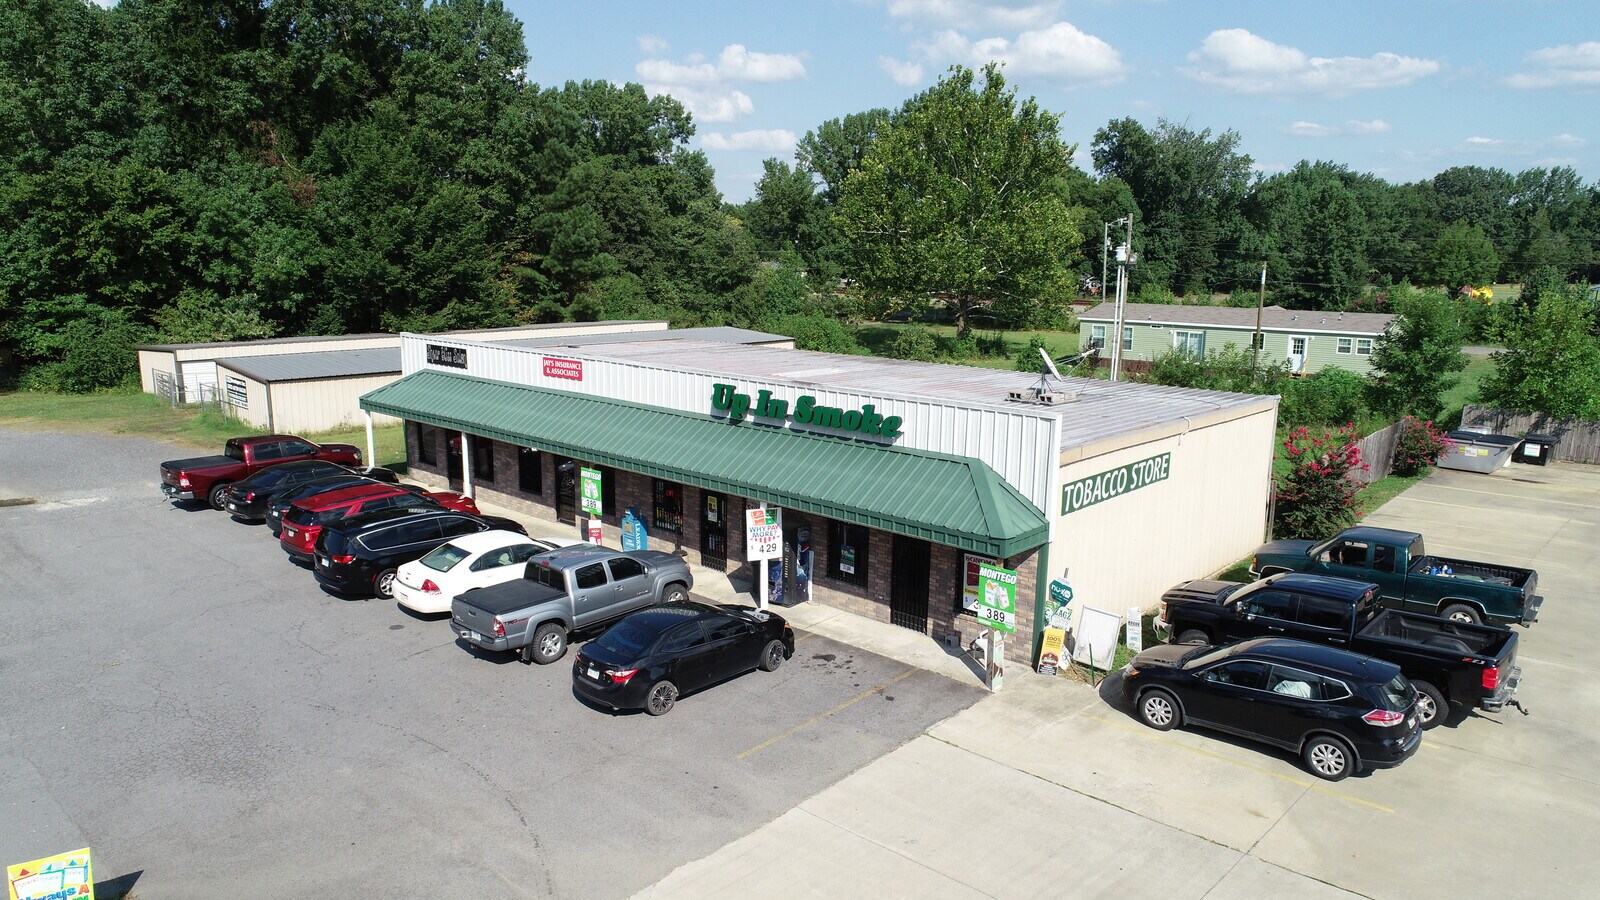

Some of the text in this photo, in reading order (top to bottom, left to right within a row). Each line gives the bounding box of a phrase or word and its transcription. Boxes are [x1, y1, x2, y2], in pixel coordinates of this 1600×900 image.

[544, 359, 581, 370] JAY'S INSURANCE
[552, 368, 579, 377] ASSOCIATES
[712, 383, 902, 437] Up In Smoke
[1064, 454, 1170, 512] TOBACCO STORE
[586, 499, 597, 508] 389
[752, 530, 778, 538] MORE?
[759, 543, 777, 553] 429
[979, 567, 1017, 585] MONTEGO
[986, 608, 1005, 622] 389
[78, 884, 90, 895] A
